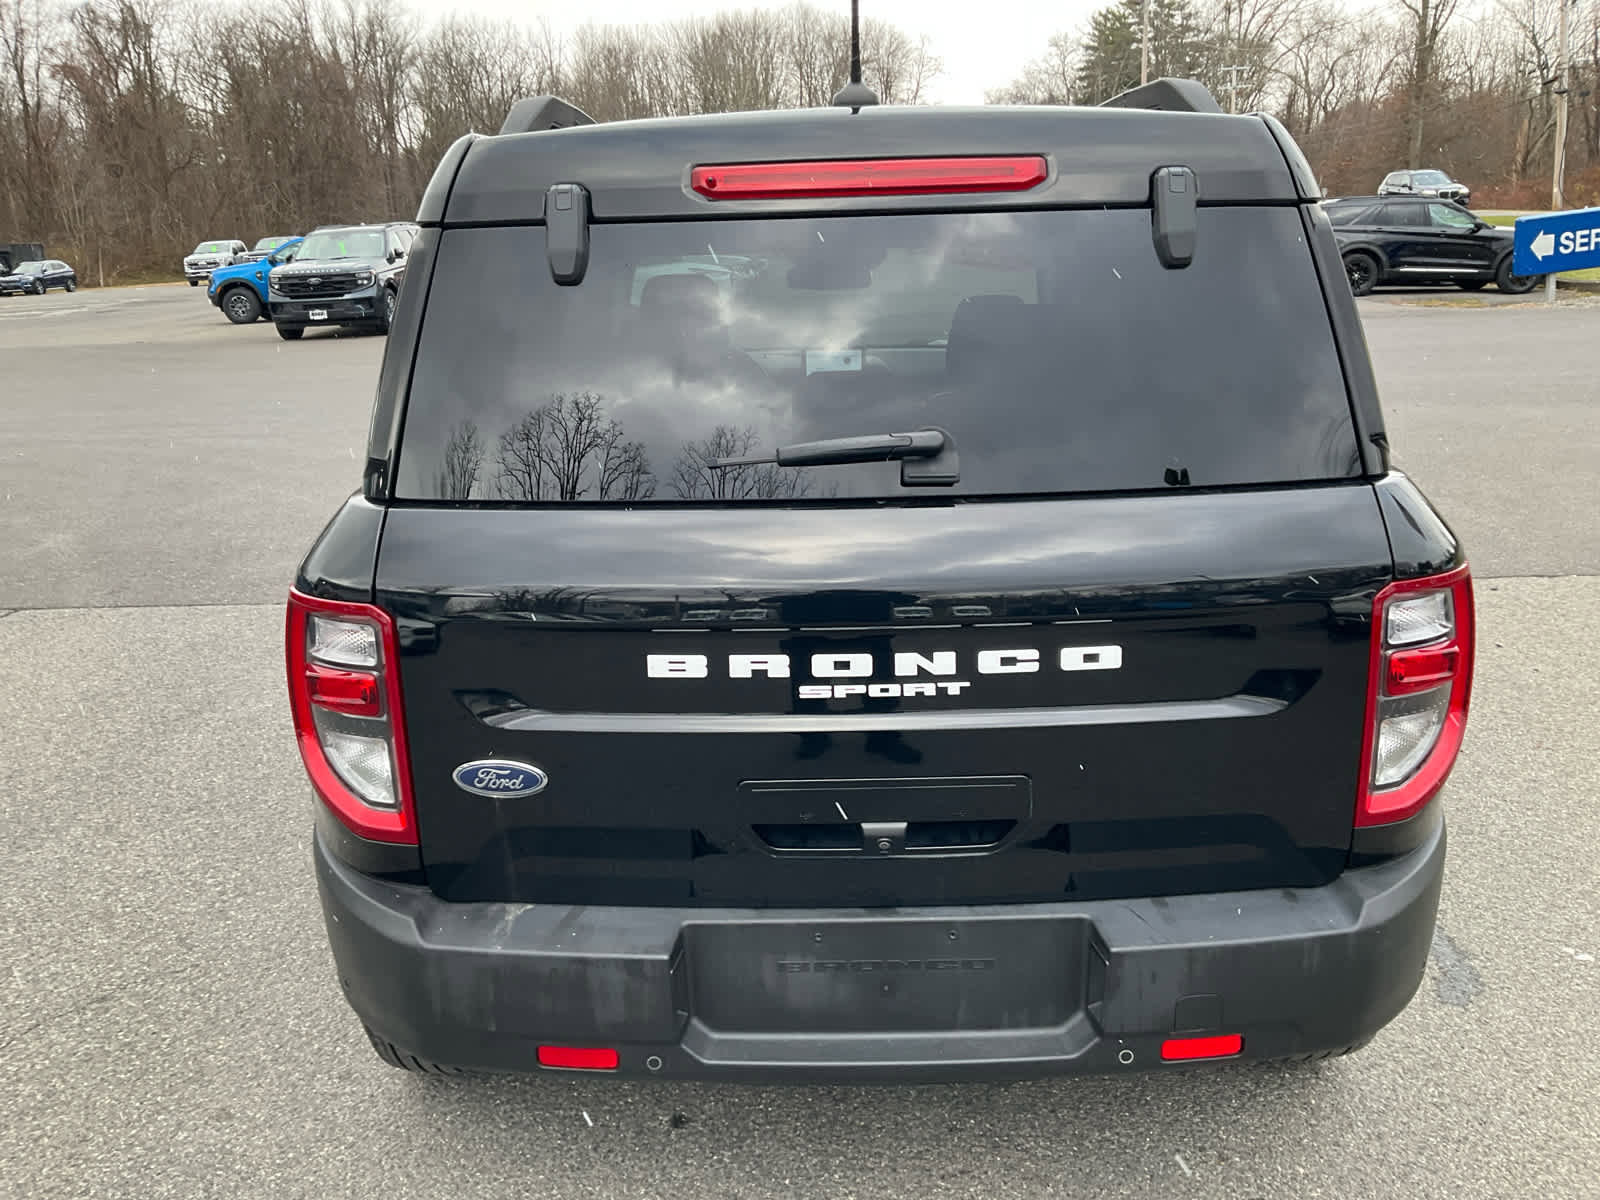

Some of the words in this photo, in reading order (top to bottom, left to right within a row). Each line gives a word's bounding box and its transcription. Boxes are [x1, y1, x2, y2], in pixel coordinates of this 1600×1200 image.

[646, 645, 1123, 679] BRONCO
[798, 681, 971, 699] SPORT
[473, 768, 524, 790] Ford
[776, 959, 995, 974] BRONCO
